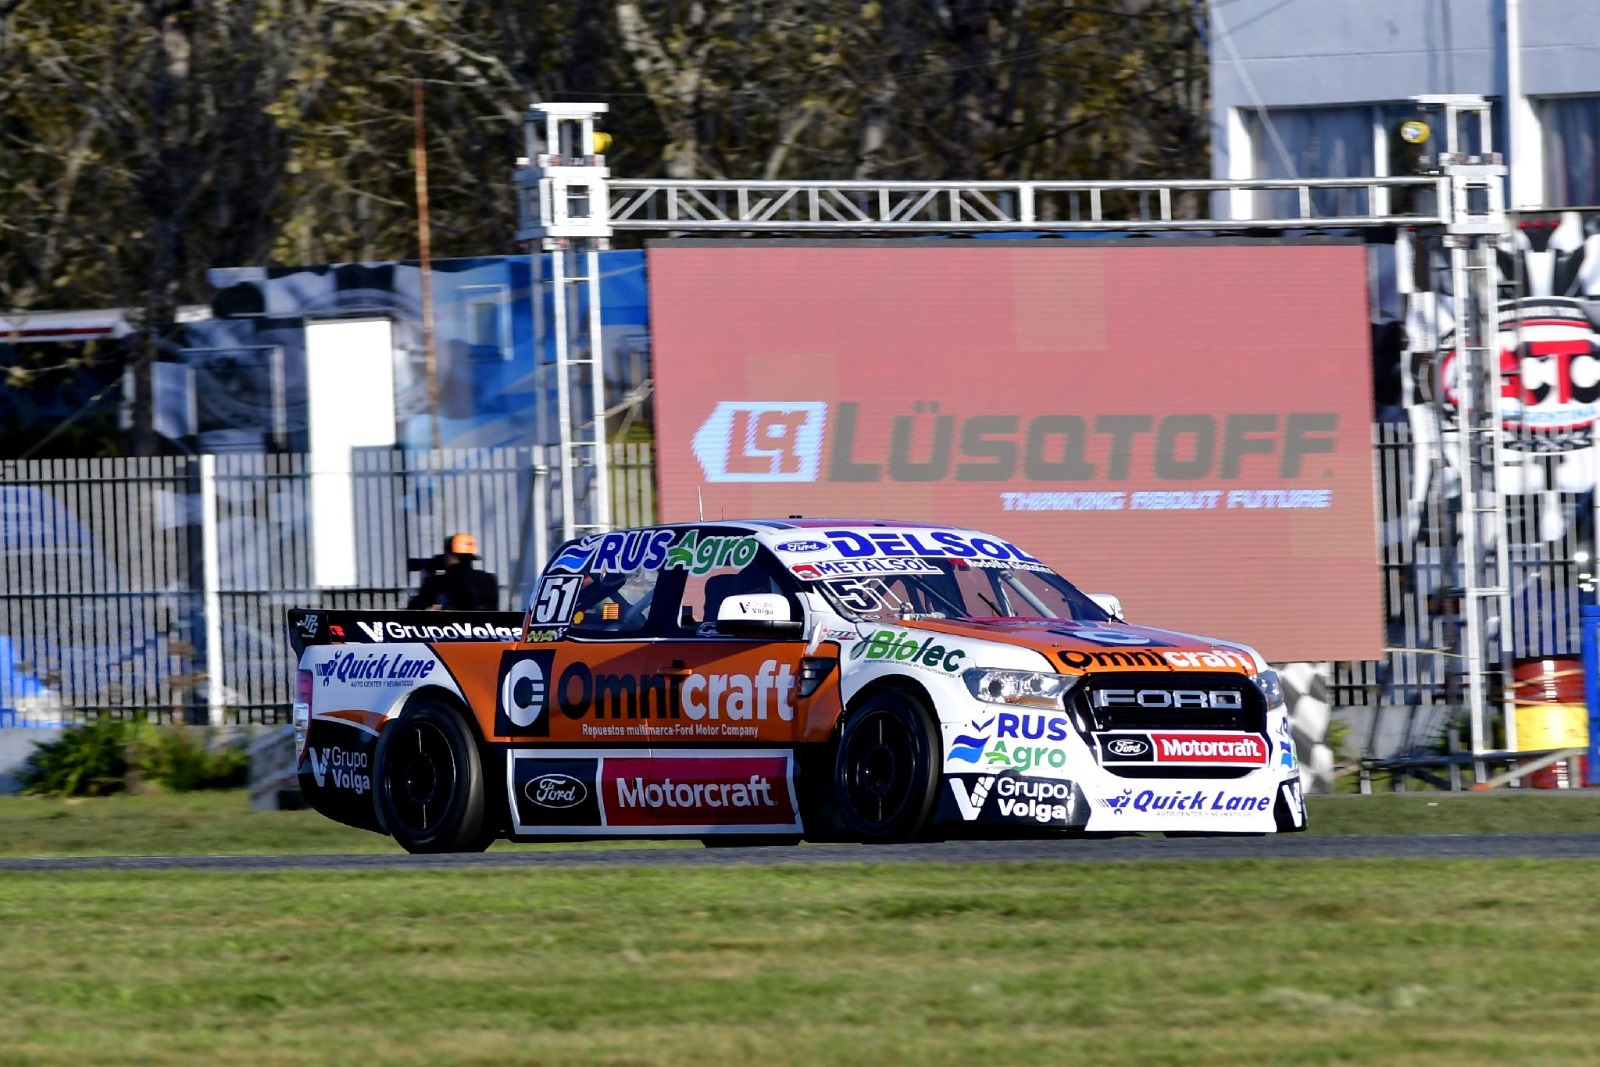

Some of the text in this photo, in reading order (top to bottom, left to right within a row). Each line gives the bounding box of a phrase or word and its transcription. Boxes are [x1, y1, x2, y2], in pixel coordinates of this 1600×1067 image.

[827, 401, 1338, 482] LÜSQTOFF
[1000, 489, 1332, 510] THINKING ABOUT FUTURE
[786, 541, 820, 551] Ford
[823, 530, 1043, 564] DELSOL
[814, 557, 938, 575] METALSOL
[537, 578, 573, 622] 51
[823, 577, 913, 613] 51
[866, 631, 965, 672] Biolec
[1057, 648, 1253, 670] Omnicraft
[337, 651, 436, 683] Quick Lane
[363, 680, 382, 688] CENTER
[557, 659, 794, 721] Omnicraft
[1092, 689, 1243, 709] FORD
[582, 723, 625, 738] Repuestos
[696, 723, 720, 736] Motor
[721, 723, 759, 738] Company
[997, 713, 1068, 742] RUS
[331, 746, 368, 771] Grupo
[986, 741, 1067, 773] Agro
[1114, 739, 1143, 755] Ford
[1163, 736, 1262, 758] Motorcraft
[332, 768, 371, 795] Volga
[535, 778, 576, 802] Ford
[616, 774, 775, 808] Motorcraft
[997, 776, 1070, 801] Grupo
[997, 798, 1069, 823] Volga
[1133, 789, 1271, 812] Quick Lane
